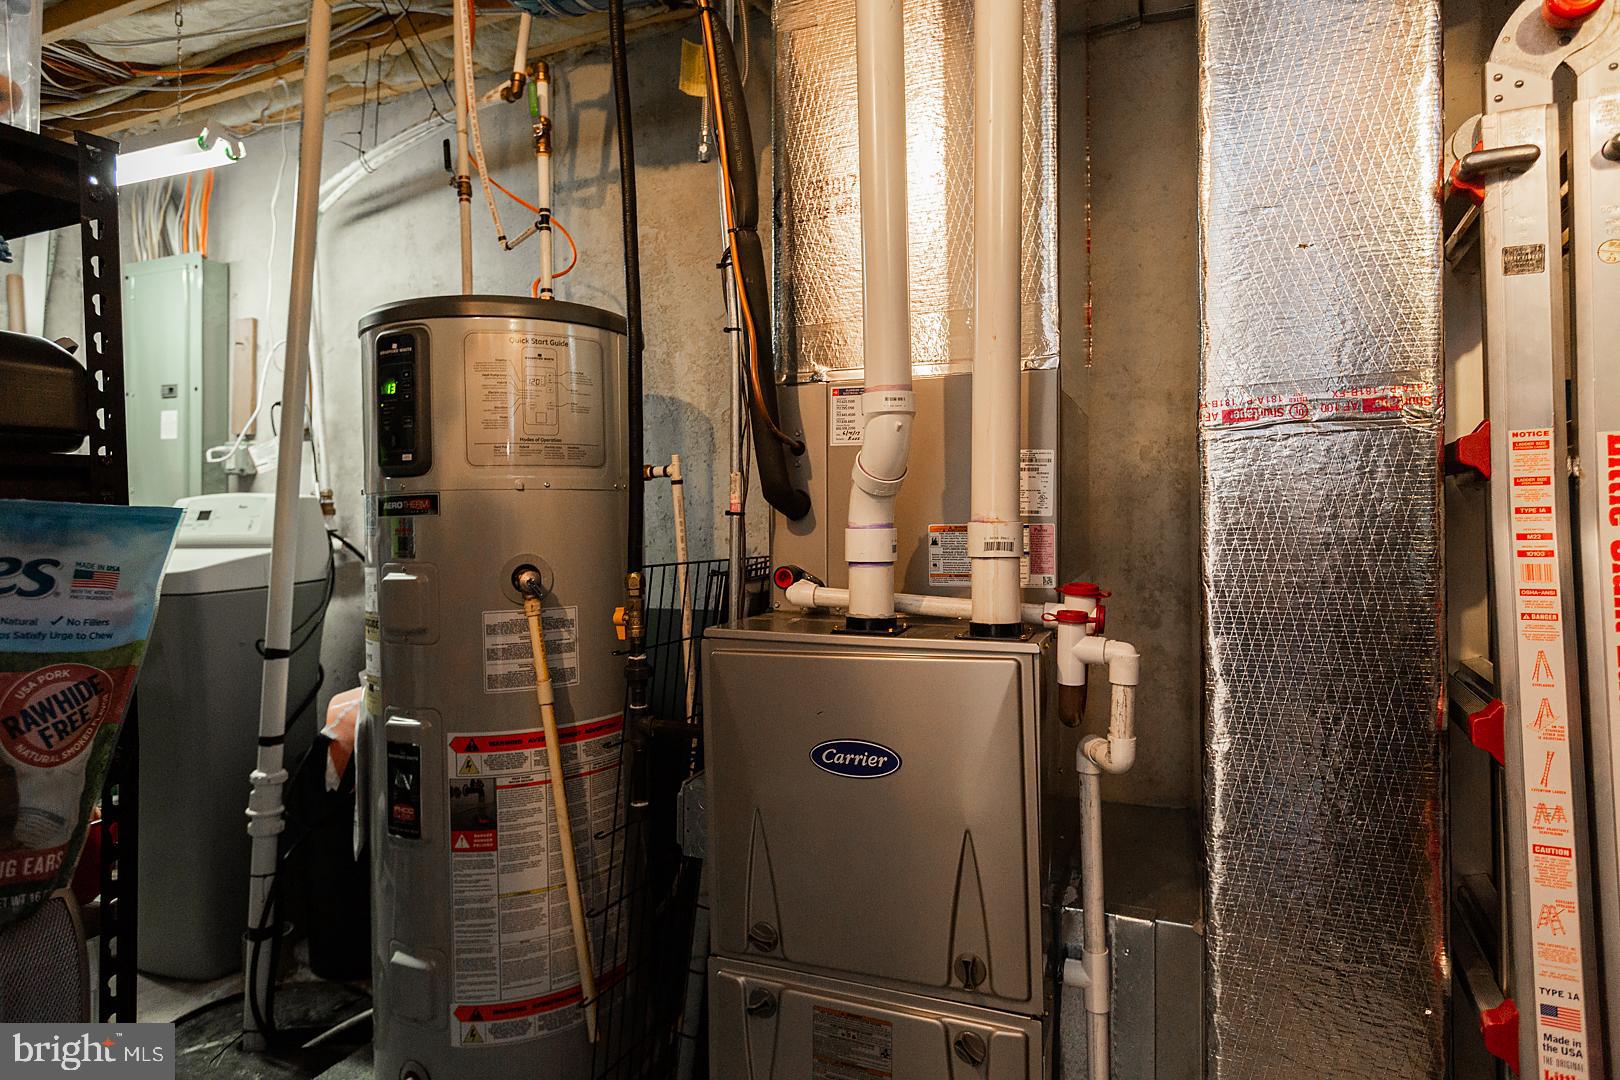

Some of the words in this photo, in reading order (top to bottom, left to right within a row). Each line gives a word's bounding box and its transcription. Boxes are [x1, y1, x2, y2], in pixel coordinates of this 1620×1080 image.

[509, 336, 529, 346] Quick
[531, 337, 548, 346] Start
[549, 338, 569, 348] Guide
[1247, 394, 1284, 405] 181A-P
[1320, 402, 1339, 413] 100
[1343, 401, 1359, 412] AF
[1512, 430, 1550, 438] NOTICE
[76, 561, 96, 570] MADE
[1, 617, 38, 626] Natural
[66, 617, 81, 626] No
[83, 618, 110, 627] Fillers
[1531, 613, 1557, 621] DANGER
[13, 631, 47, 641] Satisfy
[50, 632, 73, 641] Urge
[76, 632, 86, 640] to
[89, 631, 114, 640] Chew
[15, 680, 38, 700] USA
[36, 668, 72, 684] PORK
[1, 673, 105, 740] RAWHIDE
[38, 704, 94, 749] FREE
[14, 742, 60, 764] NATURAL
[61, 727, 95, 759] SMOKED
[821, 748, 888, 768] Carrier
[1535, 845, 1570, 857] CAUTION
[22, 850, 65, 876] EARS
[10, 893, 26, 907] WT
[1538, 986, 1564, 998] TYPE
[1567, 992, 1580, 1001] 1A
[1543, 1033, 1570, 1046] Made
[1572, 1038, 1582, 1049] in
[1542, 1043, 1558, 1054] the
[1561, 1047, 1583, 1059] USA
[1543, 1055, 1553, 1066] THE
